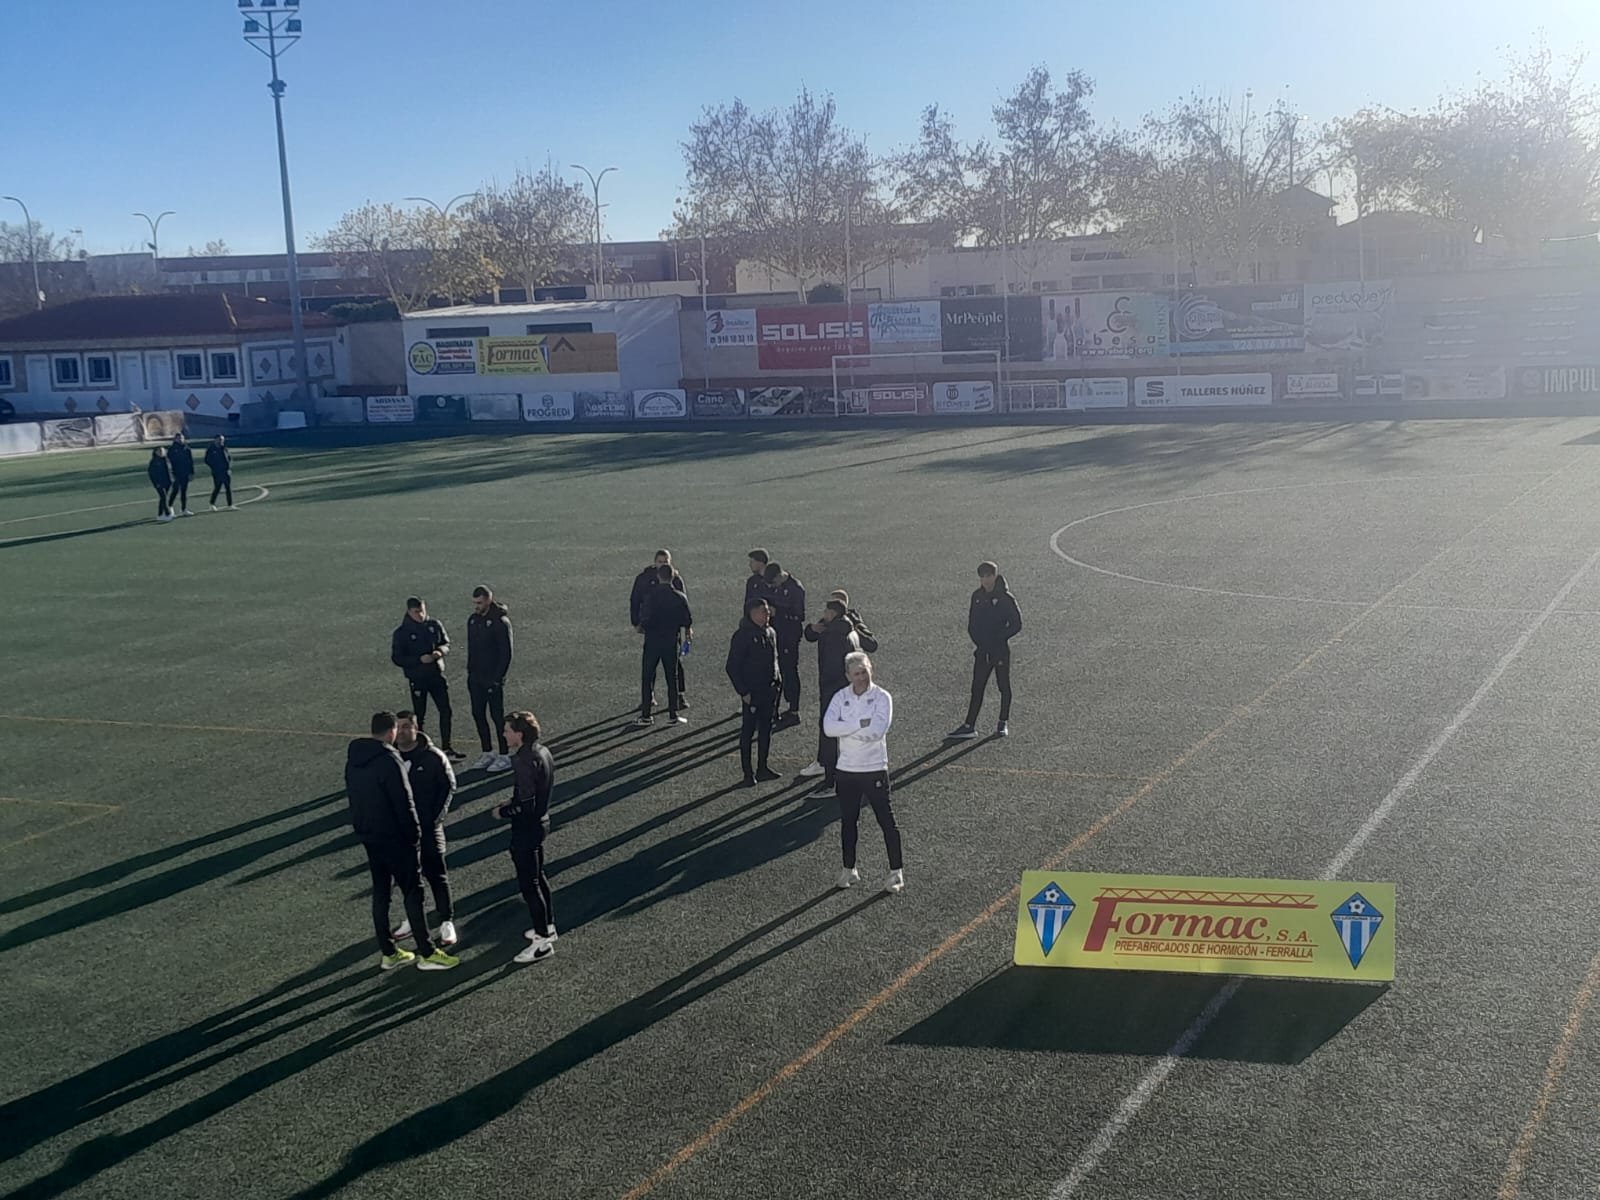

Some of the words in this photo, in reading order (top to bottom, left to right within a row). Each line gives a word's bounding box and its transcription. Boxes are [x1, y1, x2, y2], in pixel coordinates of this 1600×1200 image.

[762, 321, 864, 341] SOLISS
[412, 353, 433, 364] FAC
[487, 345, 538, 366] Formac
[872, 390, 925, 400] SOLISS
[1180, 386, 1229, 397] TALLERES
[1230, 384, 1266, 396] NÚÑEZ
[527, 408, 570, 417] PROGREDI
[1114, 940, 1190, 954] PREFABRICADOS
[1191, 942, 1205, 954] DE
[1206, 943, 1257, 957] HORMIGÓN
[1266, 947, 1313, 958] FERRALLA
